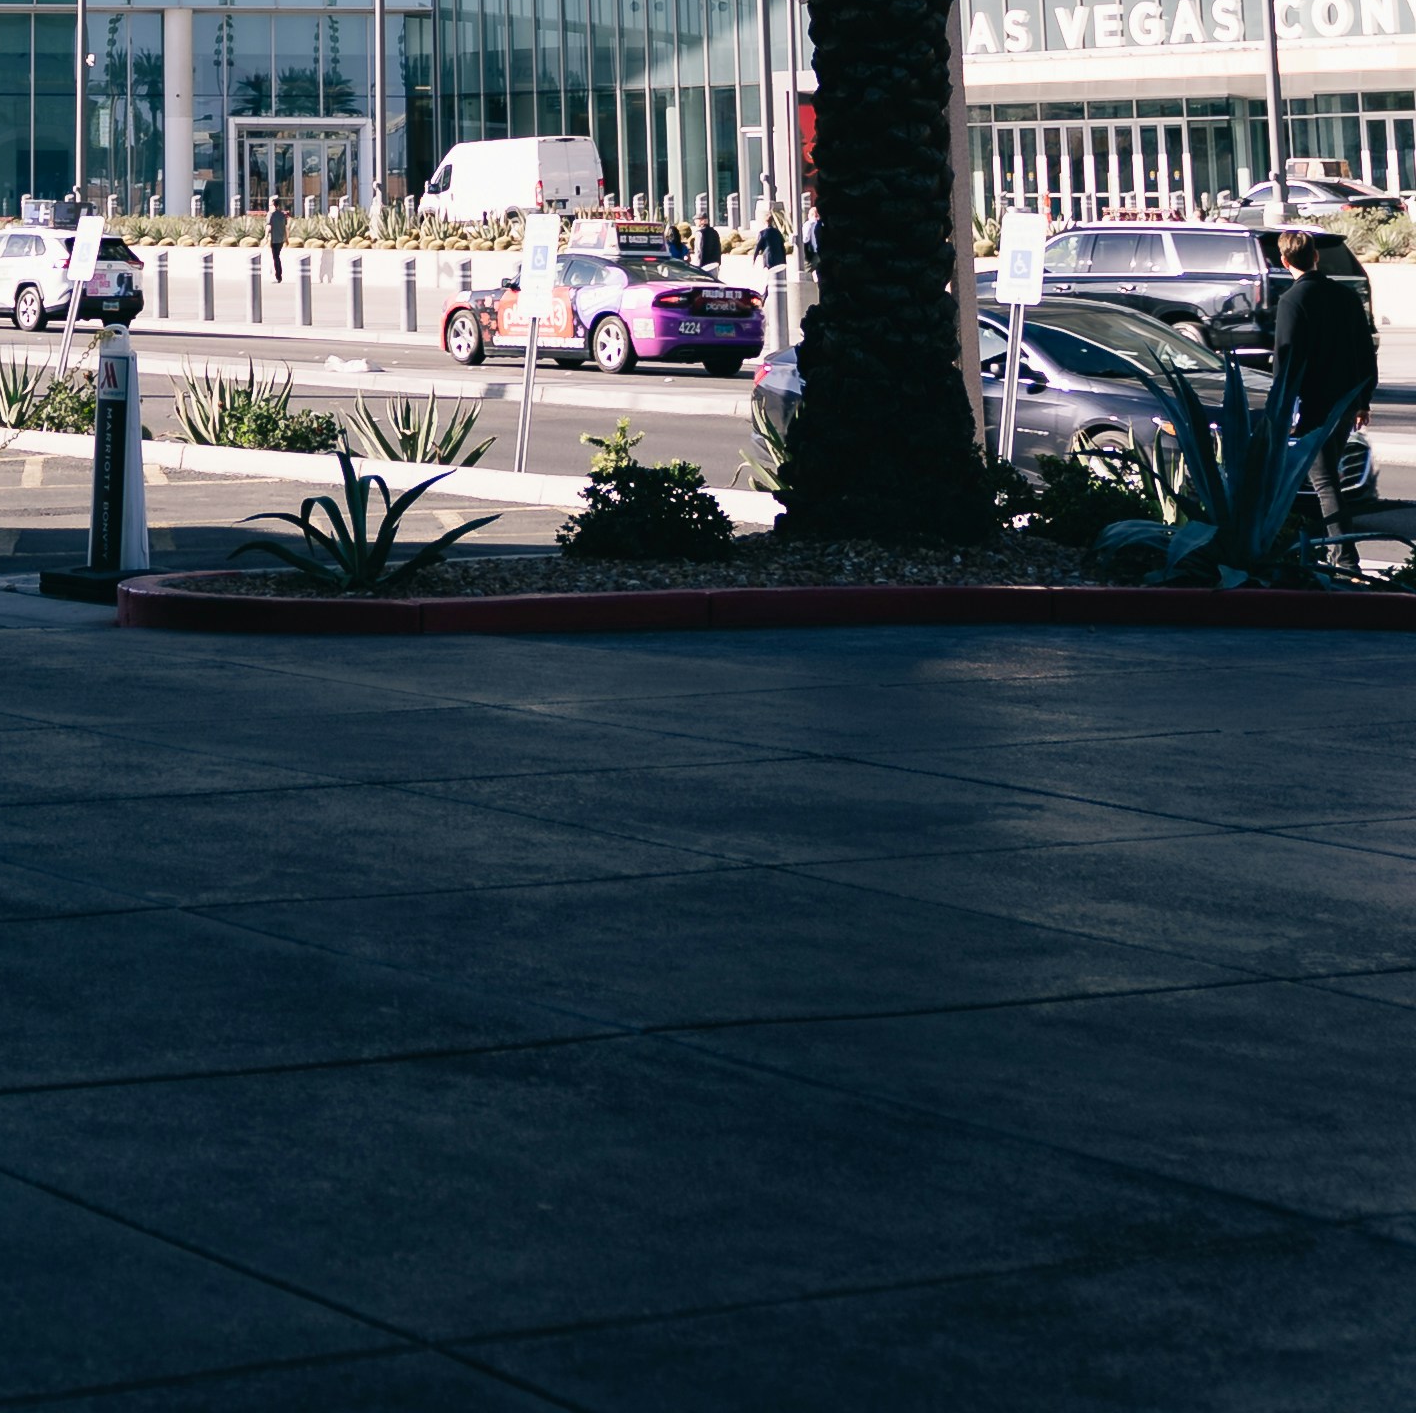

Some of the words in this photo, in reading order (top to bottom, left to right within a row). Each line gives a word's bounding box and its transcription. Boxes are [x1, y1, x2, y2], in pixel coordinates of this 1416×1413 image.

[966, 9, 1033, 53] AS
[678, 322, 701, 334] 4224
[103, 407, 113, 492] MARRIOTT
[101, 502, 111, 561] BONVOY
